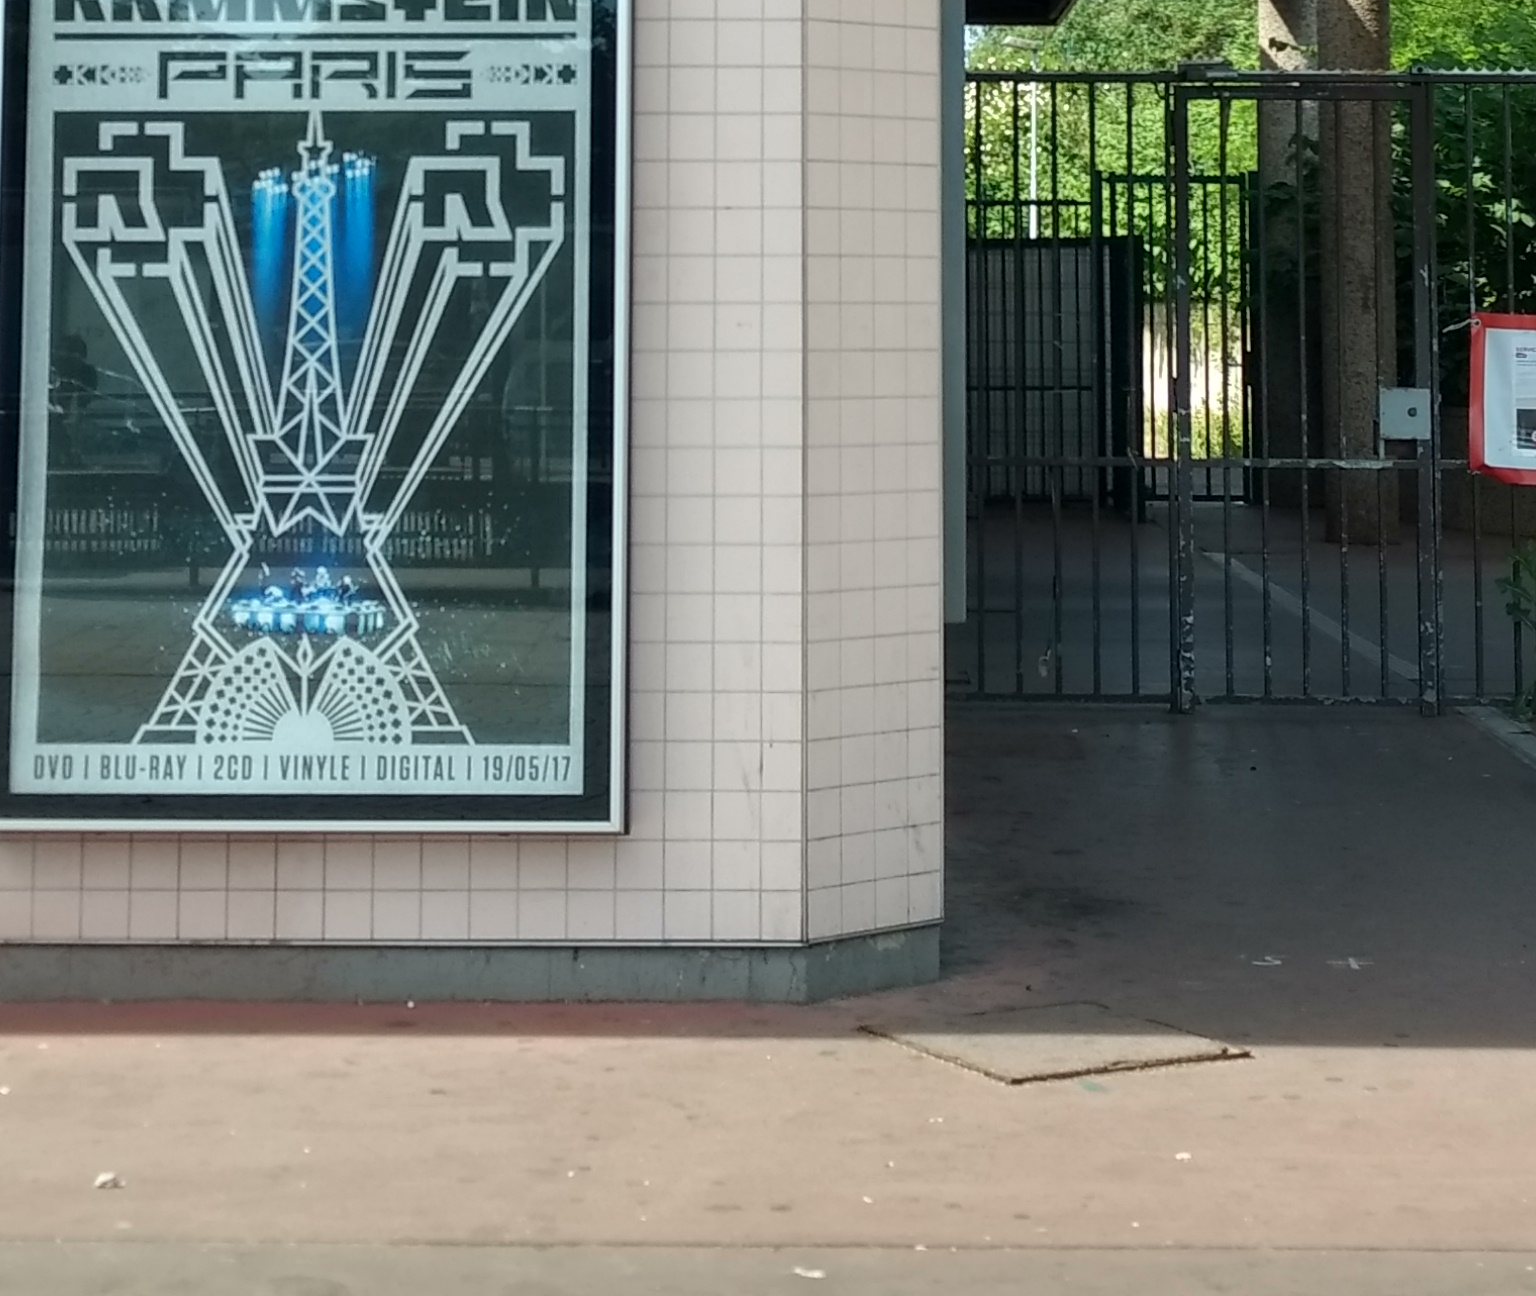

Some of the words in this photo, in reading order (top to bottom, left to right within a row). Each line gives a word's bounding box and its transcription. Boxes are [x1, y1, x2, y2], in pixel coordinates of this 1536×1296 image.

[158, 50, 472, 100] PARIS
[33, 754, 74, 781] DVD
[100, 754, 187, 781] BLU-RAY
[213, 754, 253, 781] 2CD
[280, 754, 350, 781] VINYLE
[376, 755, 455, 781] DIGITAL
[482, 755, 571, 782] 19/05/17
